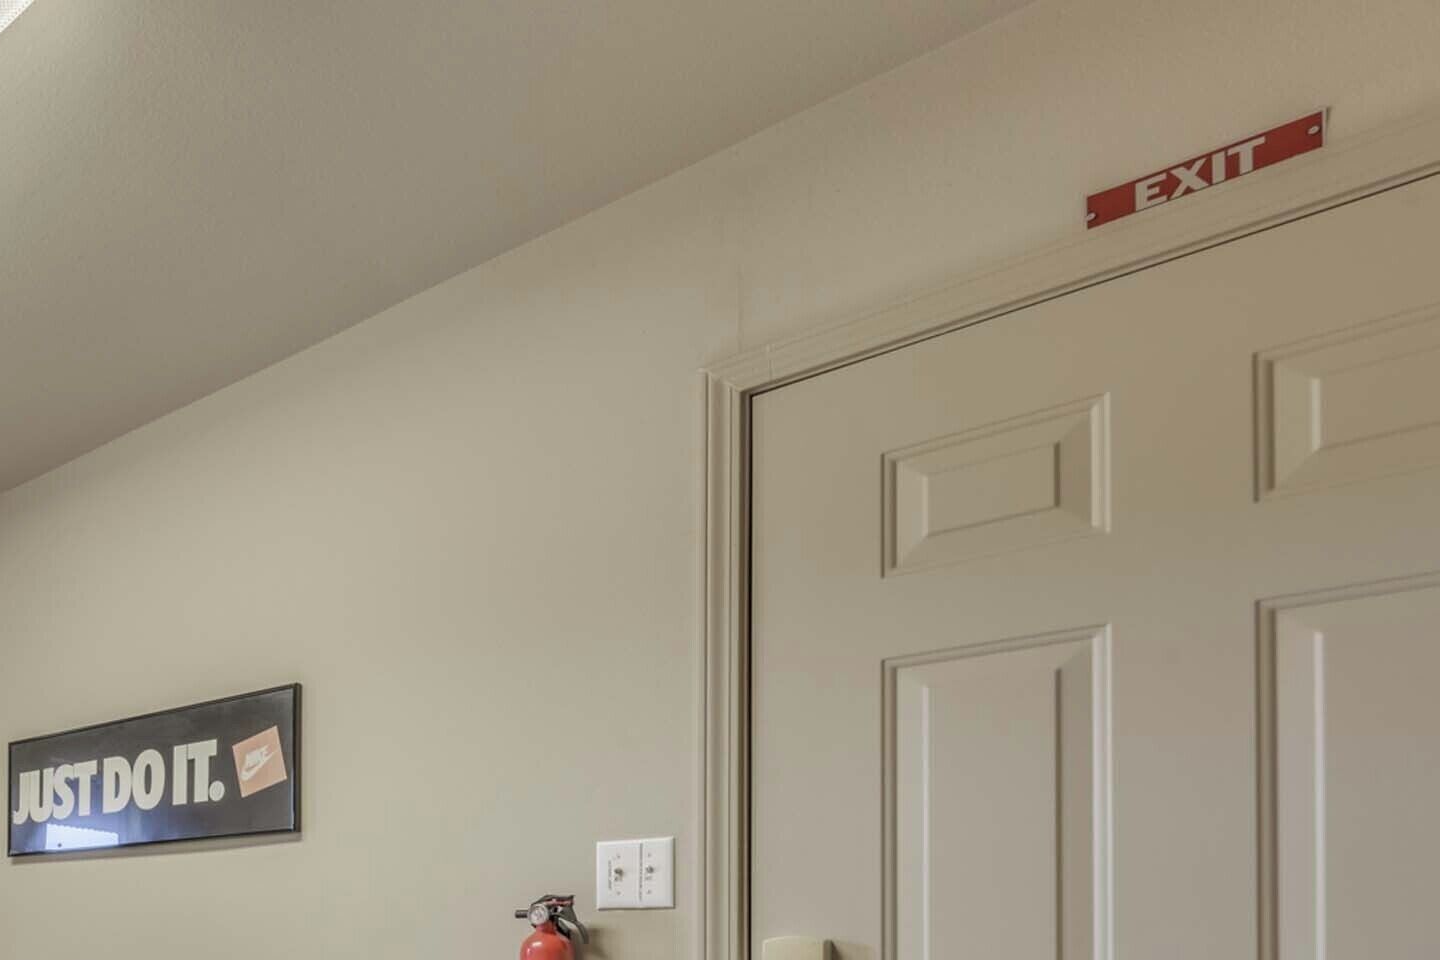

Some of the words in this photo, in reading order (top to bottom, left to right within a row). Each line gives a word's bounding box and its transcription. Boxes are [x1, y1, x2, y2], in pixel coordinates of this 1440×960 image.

[1134, 136, 1266, 212] EXIT
[12, 760, 98, 825] JUST
[102, 749, 166, 814] DO
[172, 739, 226, 806] IT.
